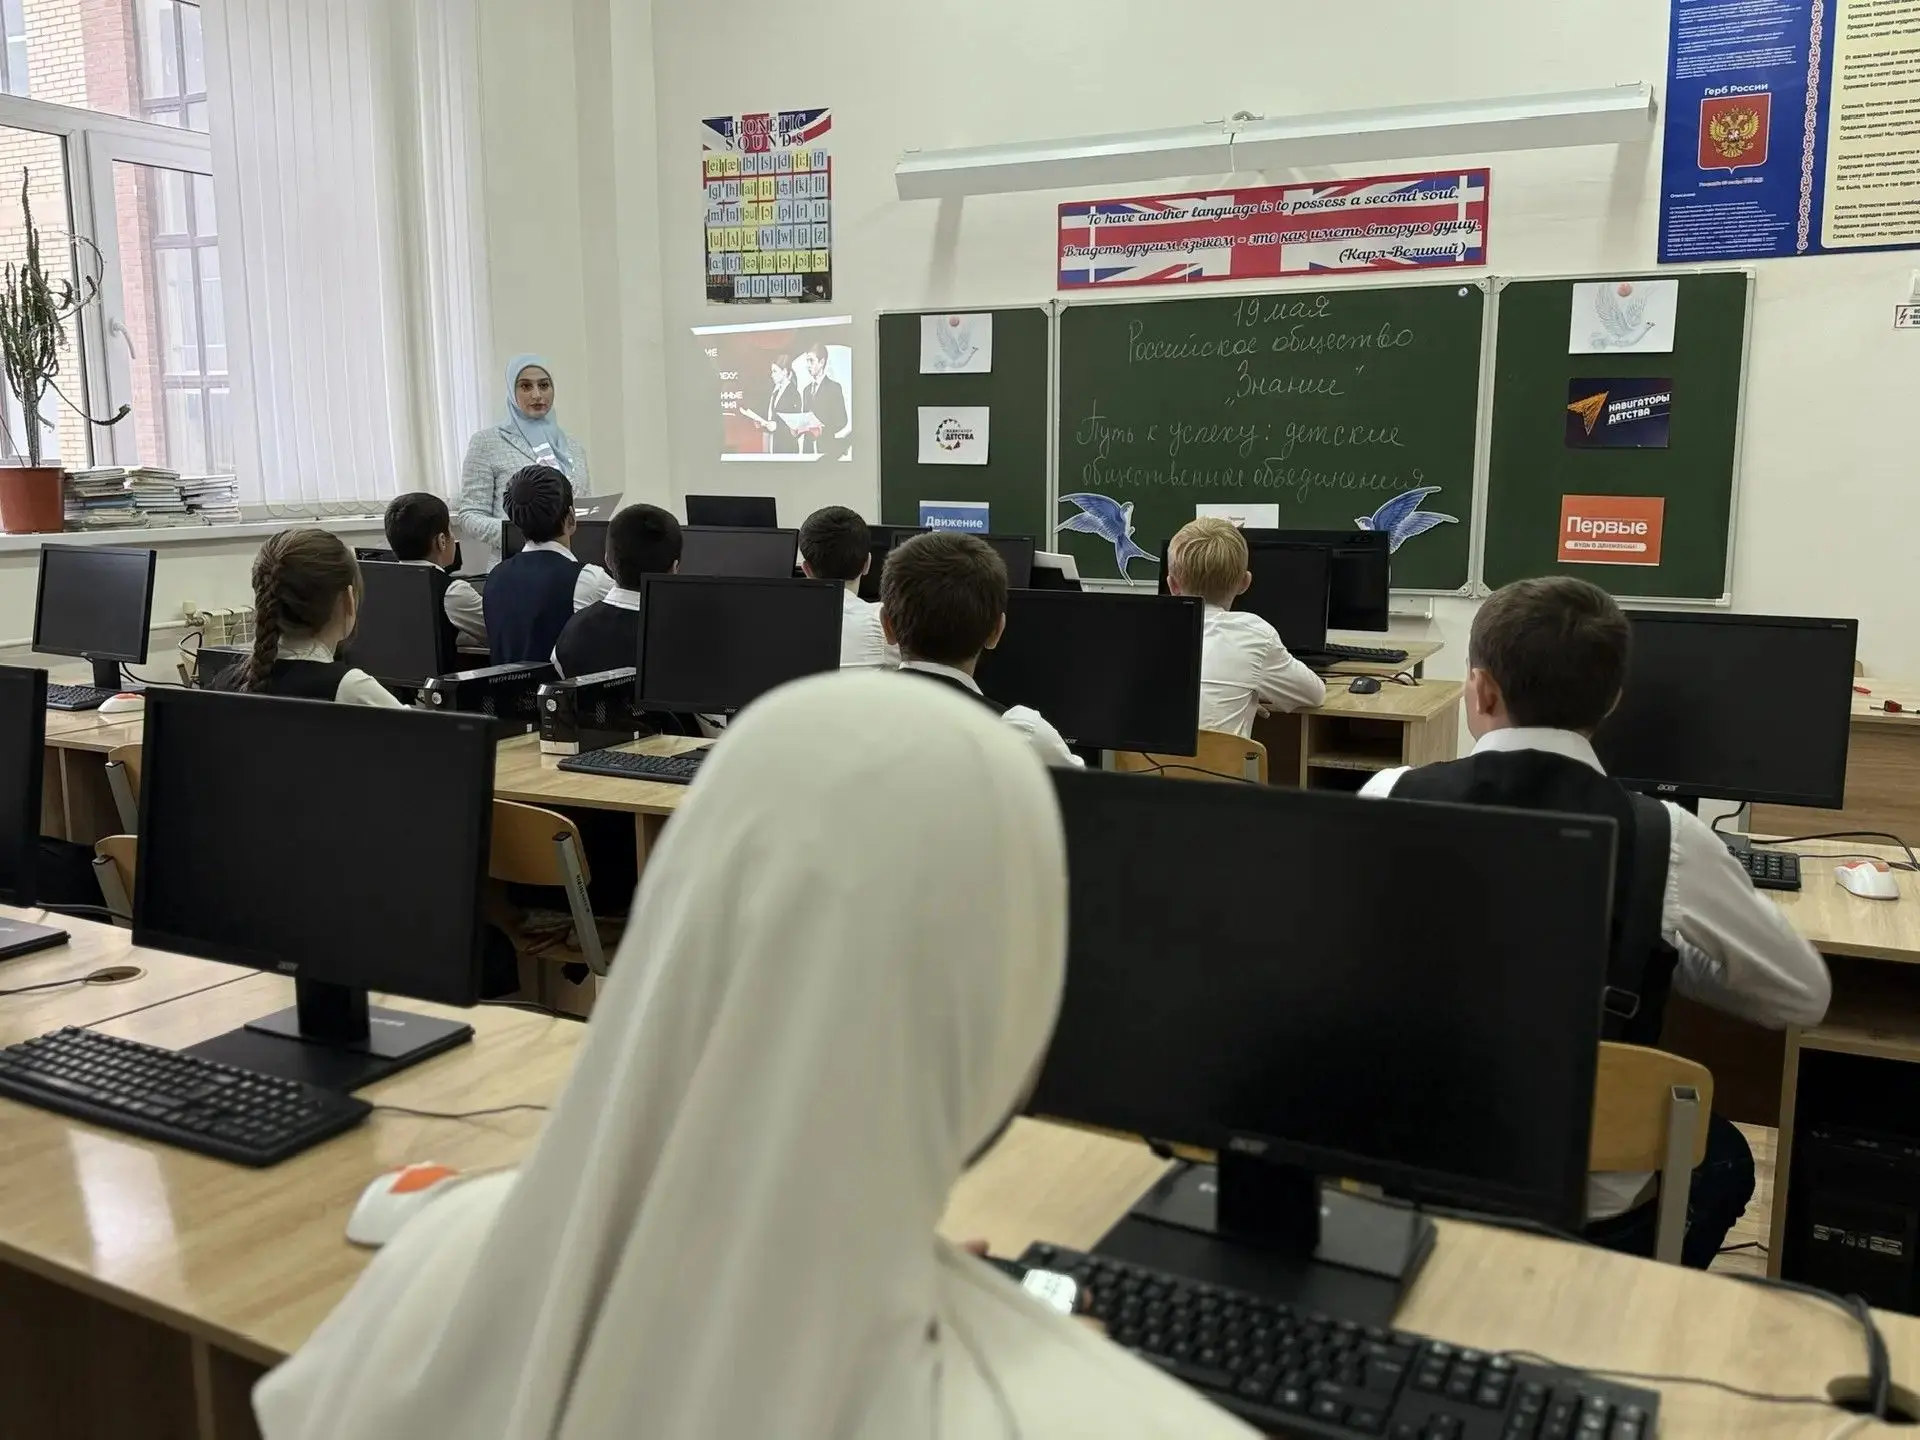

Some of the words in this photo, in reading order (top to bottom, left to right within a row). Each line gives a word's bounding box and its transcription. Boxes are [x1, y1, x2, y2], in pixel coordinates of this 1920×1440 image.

[1704, 86, 1728, 96] Герб
[1731, 84, 1768, 93] России
[724, 114, 806, 137] PHONETIC
[725, 132, 804, 150] SOUNDS
[1087, 214, 1101, 225] To
[1104, 213, 1135, 225] have
[1139, 207, 1188, 222] another
[1192, 204, 1256, 222] language
[1260, 202, 1272, 214] is
[1276, 199, 1289, 212] to
[1292, 196, 1346, 214] possess
[1350, 196, 1360, 206] a
[1365, 191, 1416, 205] second
[1421, 187, 1459, 200] soul.
[1064, 245, 1123, 260] Владеть
[1126, 242, 1177, 258] другим
[1180, 234, 1234, 254] языком
[1248, 232, 1279, 245] это
[1280, 230, 1305, 244] как
[1309, 226, 1361, 239] иметь
[1365, 222, 1430, 238] вторую
[1433, 219, 1481, 236] душу.
[1234, 299, 1259, 326] 19
[1264, 296, 1333, 322] мая
[1128, 320, 1257, 365] Российское
[1272, 322, 1414, 354] общество
[1608, 394, 1670, 412] НАВИГАТОРЫ
[1608, 408, 1650, 425] ДЕТСТВА
[1076, 399, 1134, 459] Путь
[1147, 424, 1158, 441] к
[1282, 422, 1404, 459] детские
[925, 516, 983, 528] Движение
[1567, 516, 1648, 538] Первые
